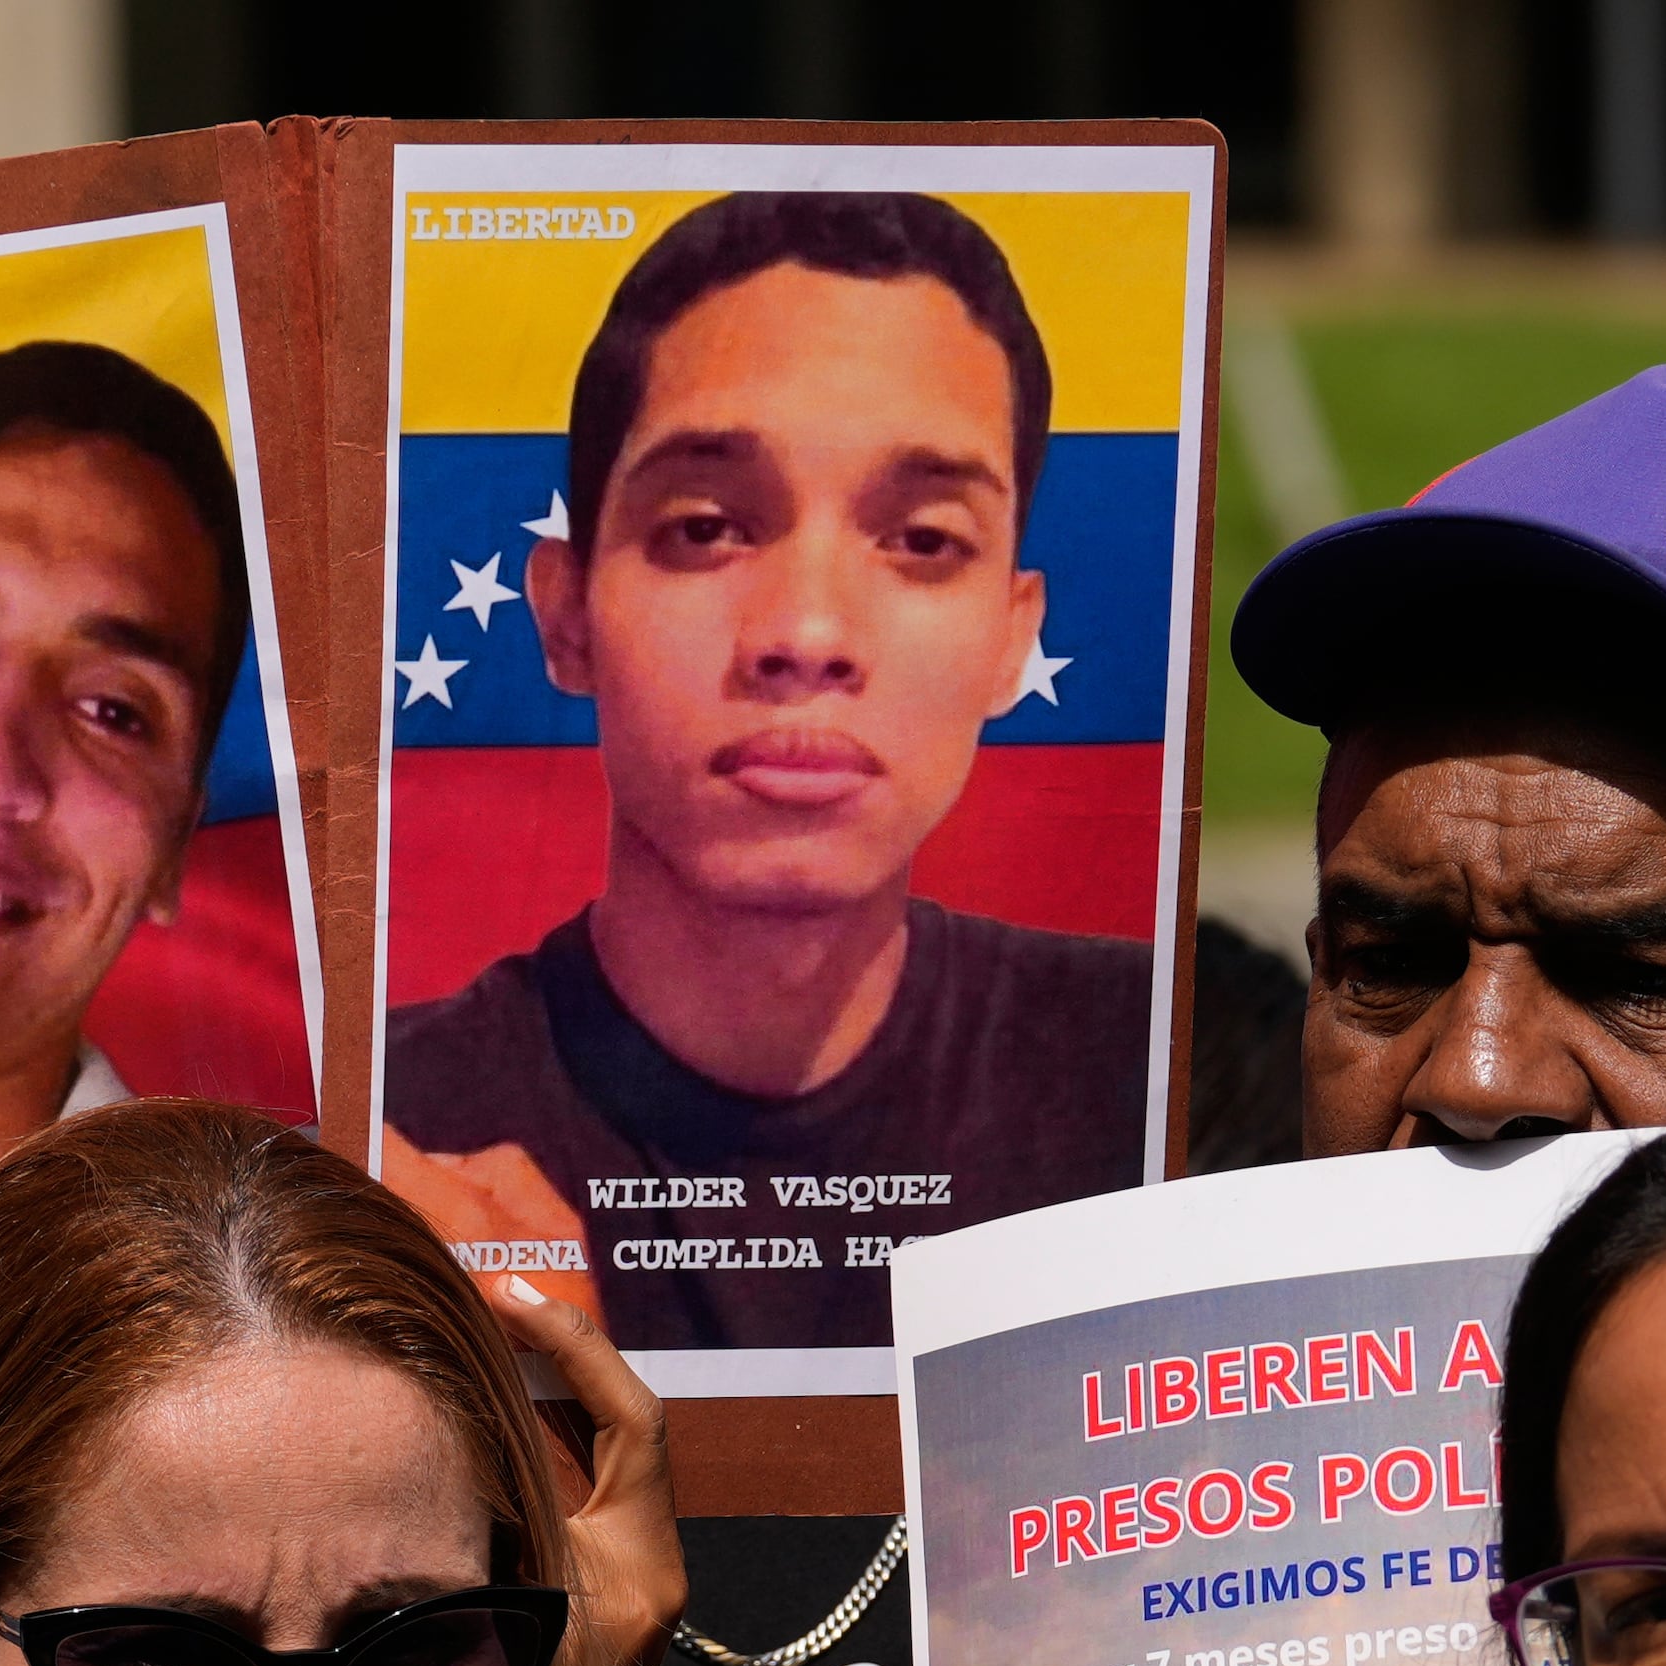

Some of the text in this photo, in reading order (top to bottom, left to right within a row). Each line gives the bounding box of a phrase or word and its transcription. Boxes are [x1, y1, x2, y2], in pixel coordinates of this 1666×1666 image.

[410, 206, 637, 241] LIBERTAD
[587, 1174, 953, 1214] WILDER VASQUEZ
[446, 1239, 589, 1272] NDENA
[612, 1237, 823, 1271] CUMPLIDA
[1082, 1325, 1418, 1443] LIBEREN
[1009, 1460, 1296, 1579] PRESOS
[1142, 1543, 1503, 1622] EXIGIMOS FE DE
